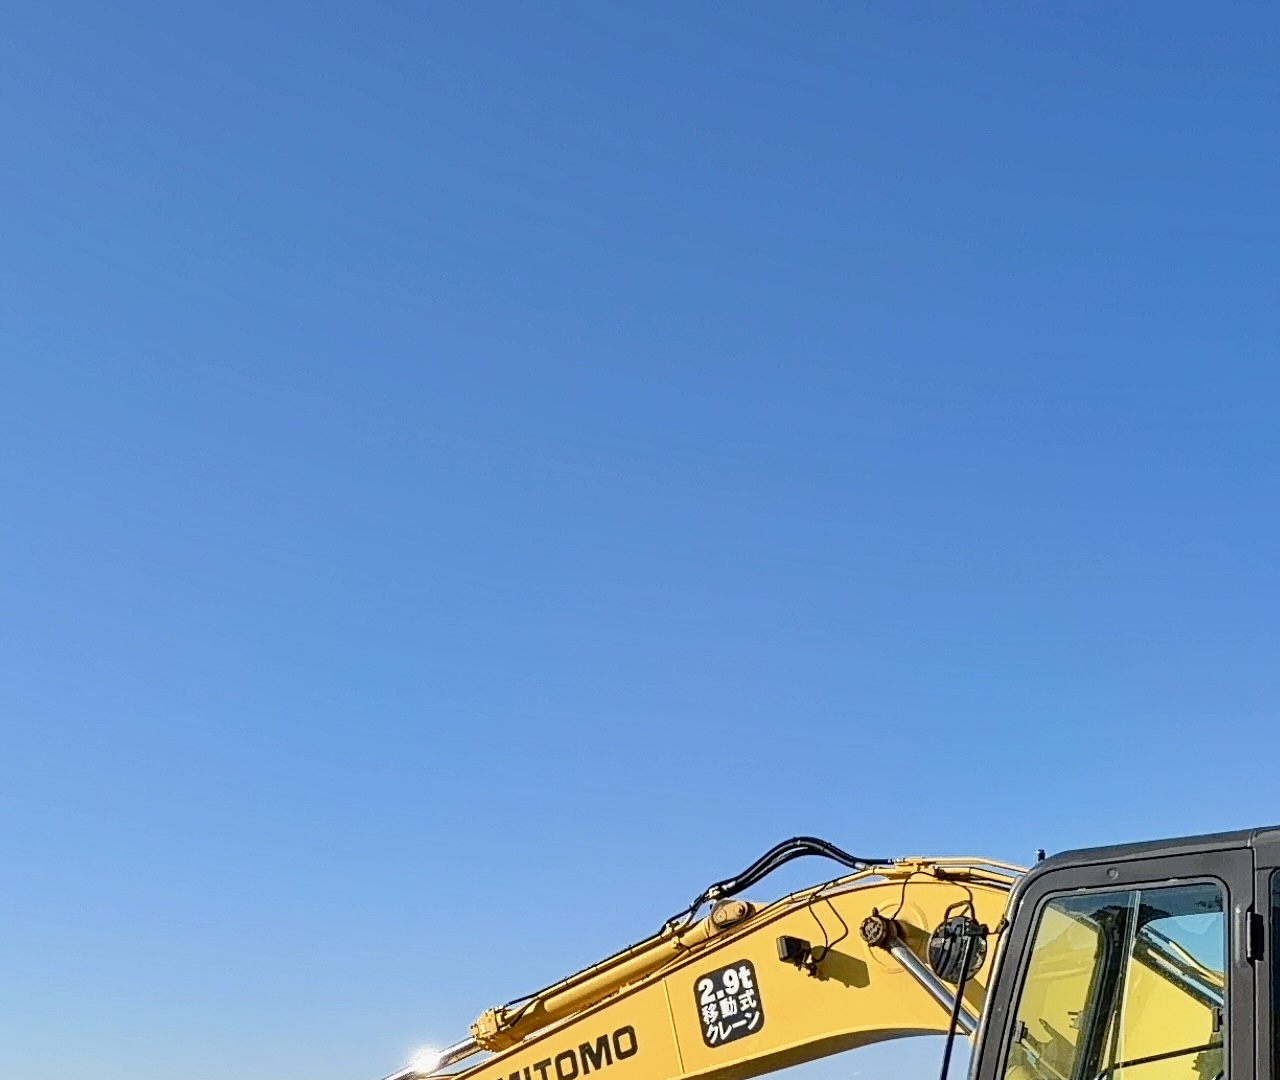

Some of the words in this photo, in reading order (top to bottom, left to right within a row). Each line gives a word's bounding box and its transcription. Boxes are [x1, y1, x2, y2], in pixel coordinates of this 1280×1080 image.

[698, 966, 753, 1005] 2.9t
[701, 988, 757, 1025] 移動式
[706, 1011, 760, 1043] クレーン
